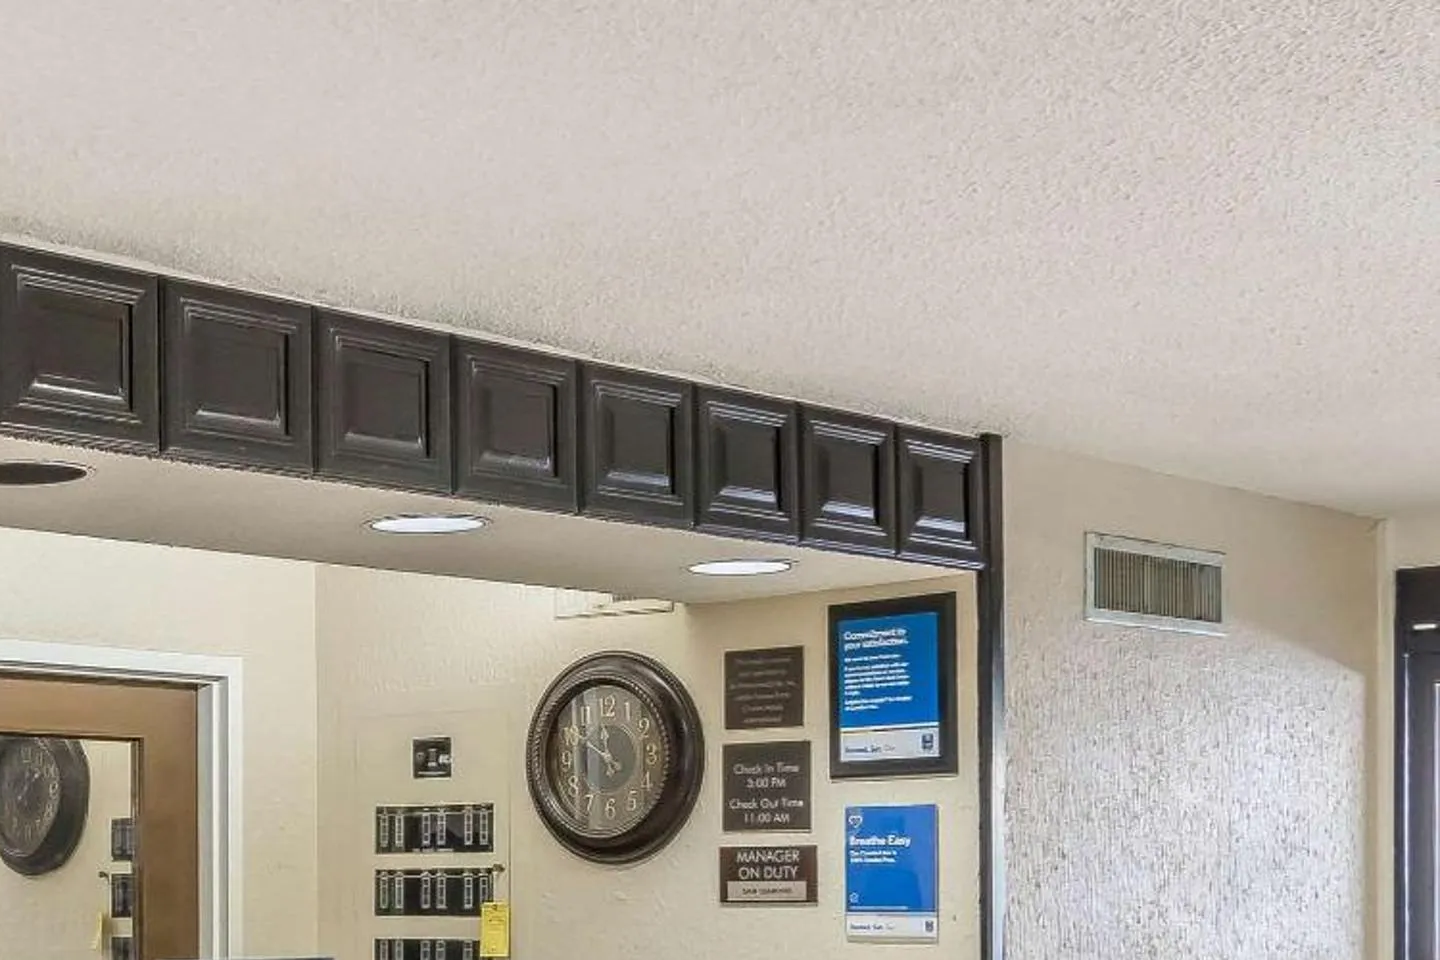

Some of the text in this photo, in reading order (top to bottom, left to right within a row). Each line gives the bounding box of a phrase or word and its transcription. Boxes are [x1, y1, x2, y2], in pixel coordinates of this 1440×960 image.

[599, 694, 616, 718] 12
[624, 702, 631, 721] 1
[637, 717, 650, 739] 2
[562, 750, 572, 772] 9
[646, 742, 658, 765] 3
[733, 763, 761, 775] Check
[776, 761, 800, 773] Time
[568, 775, 579, 797] 8
[641, 771, 653, 792] 4
[771, 777, 787, 788] PM
[585, 794, 595, 812] 7
[605, 798, 617, 820] 6
[626, 790, 637, 812] 5
[728, 798, 759, 809] Check
[781, 797, 804, 808] Time
[773, 813, 790, 824] AM
[849, 835, 911, 848] Breathe Easy
[736, 849, 800, 863] MANAGER
[738, 865, 799, 880] ON DUTY
